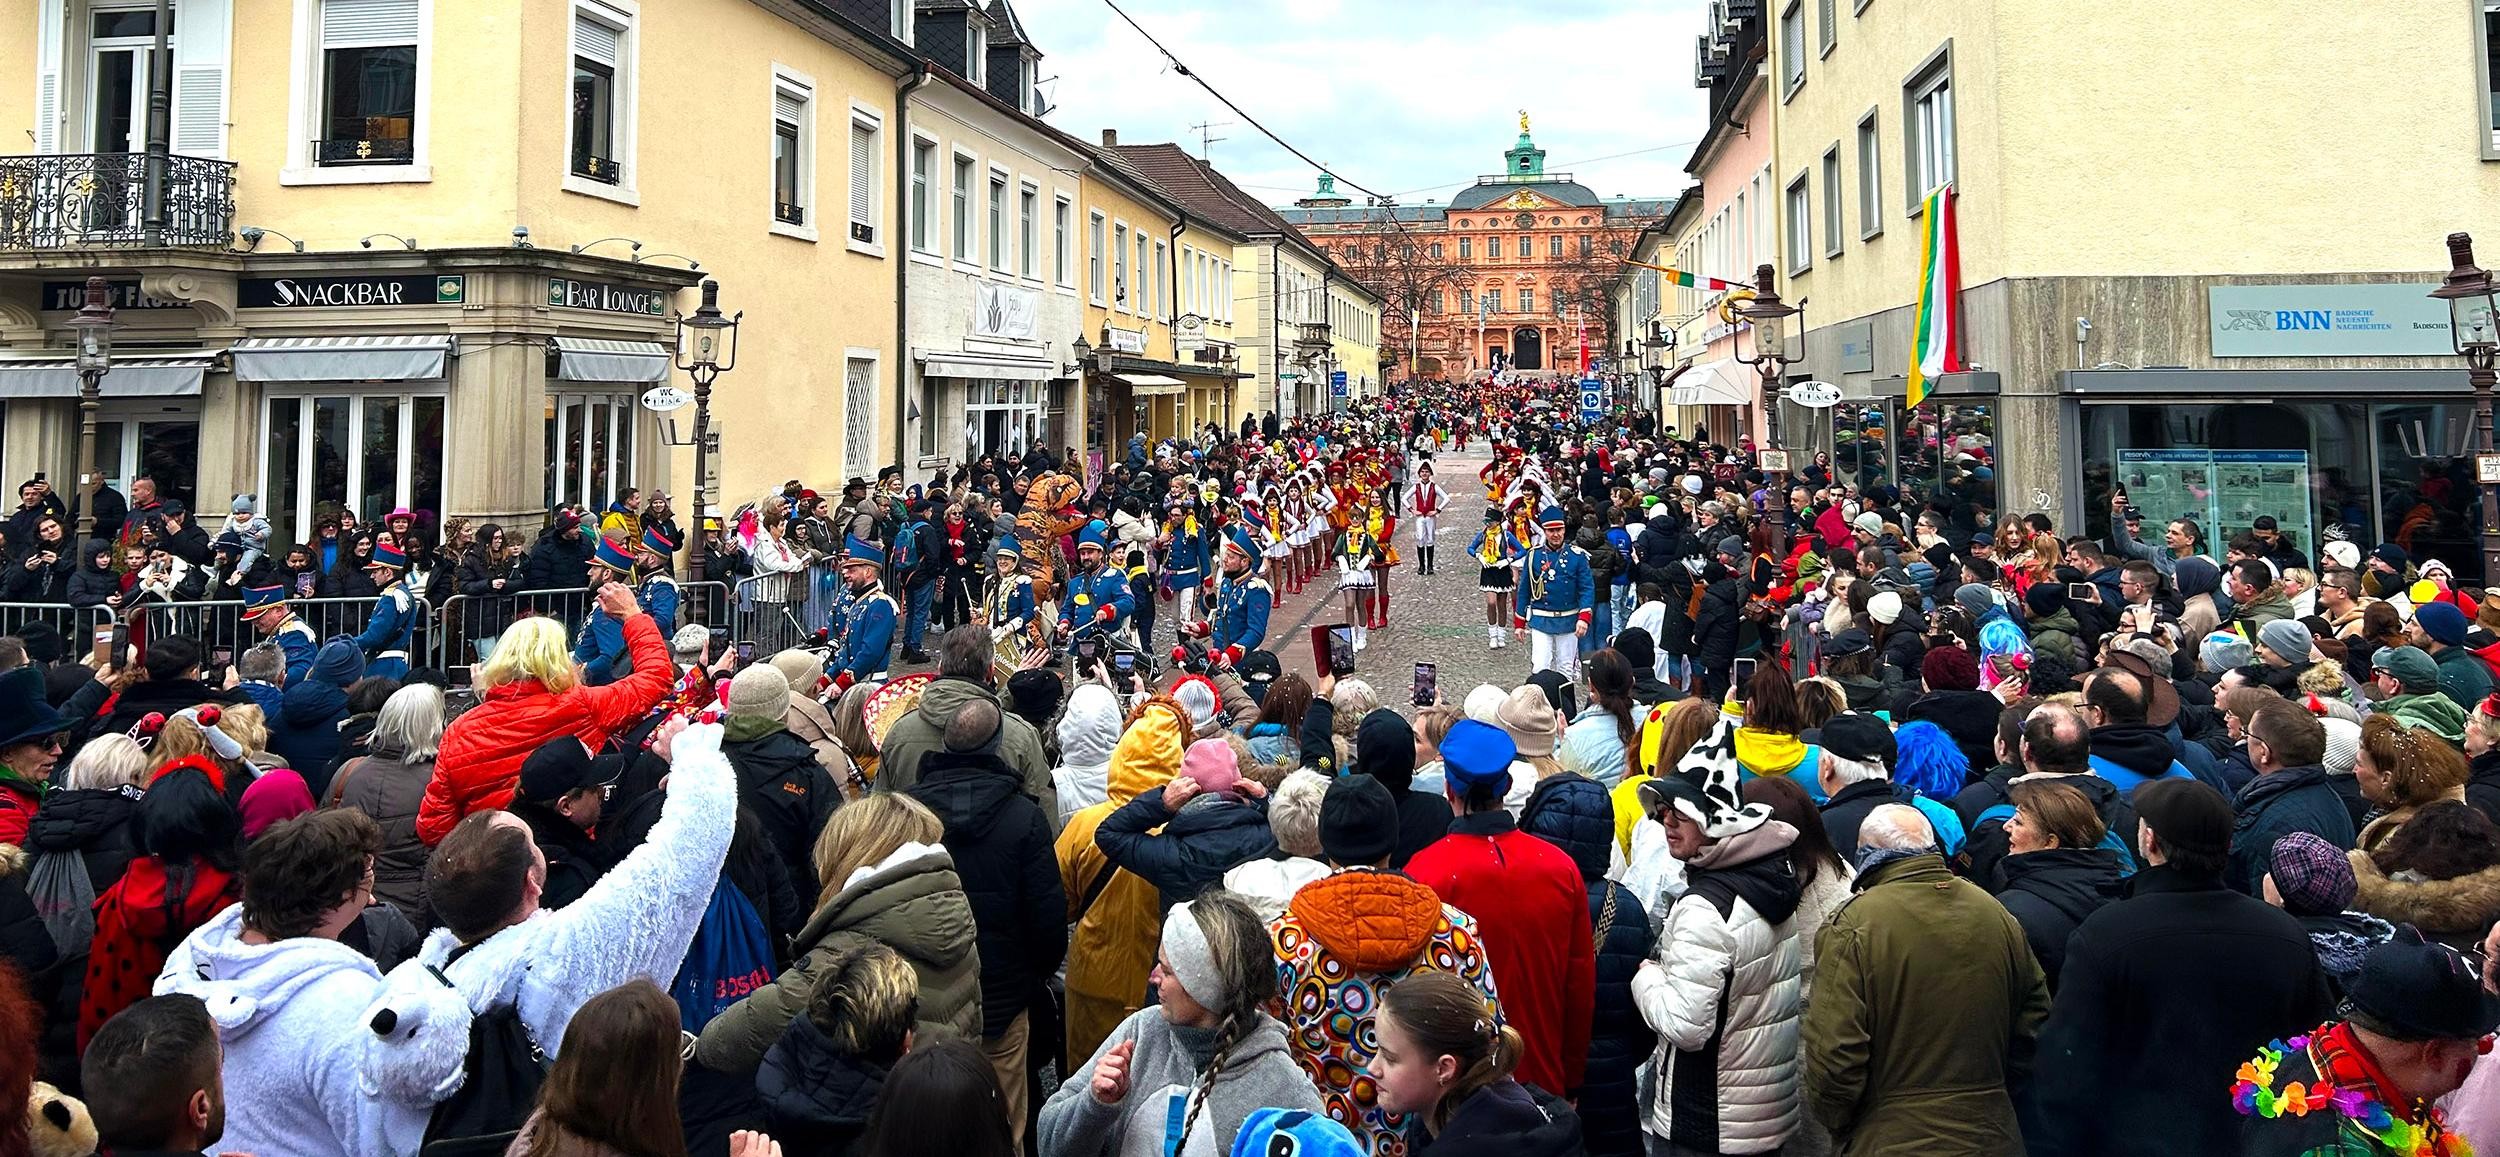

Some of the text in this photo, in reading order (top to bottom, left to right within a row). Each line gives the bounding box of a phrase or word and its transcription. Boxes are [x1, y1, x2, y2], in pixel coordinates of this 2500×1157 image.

[272, 279, 403, 306] SNACKBAR
[566, 280, 649, 313] BAR LOUNGE
[2275, 310, 2331, 330] BNN
[659, 388, 673, 397] WC
[1806, 383, 1822, 392] WC
